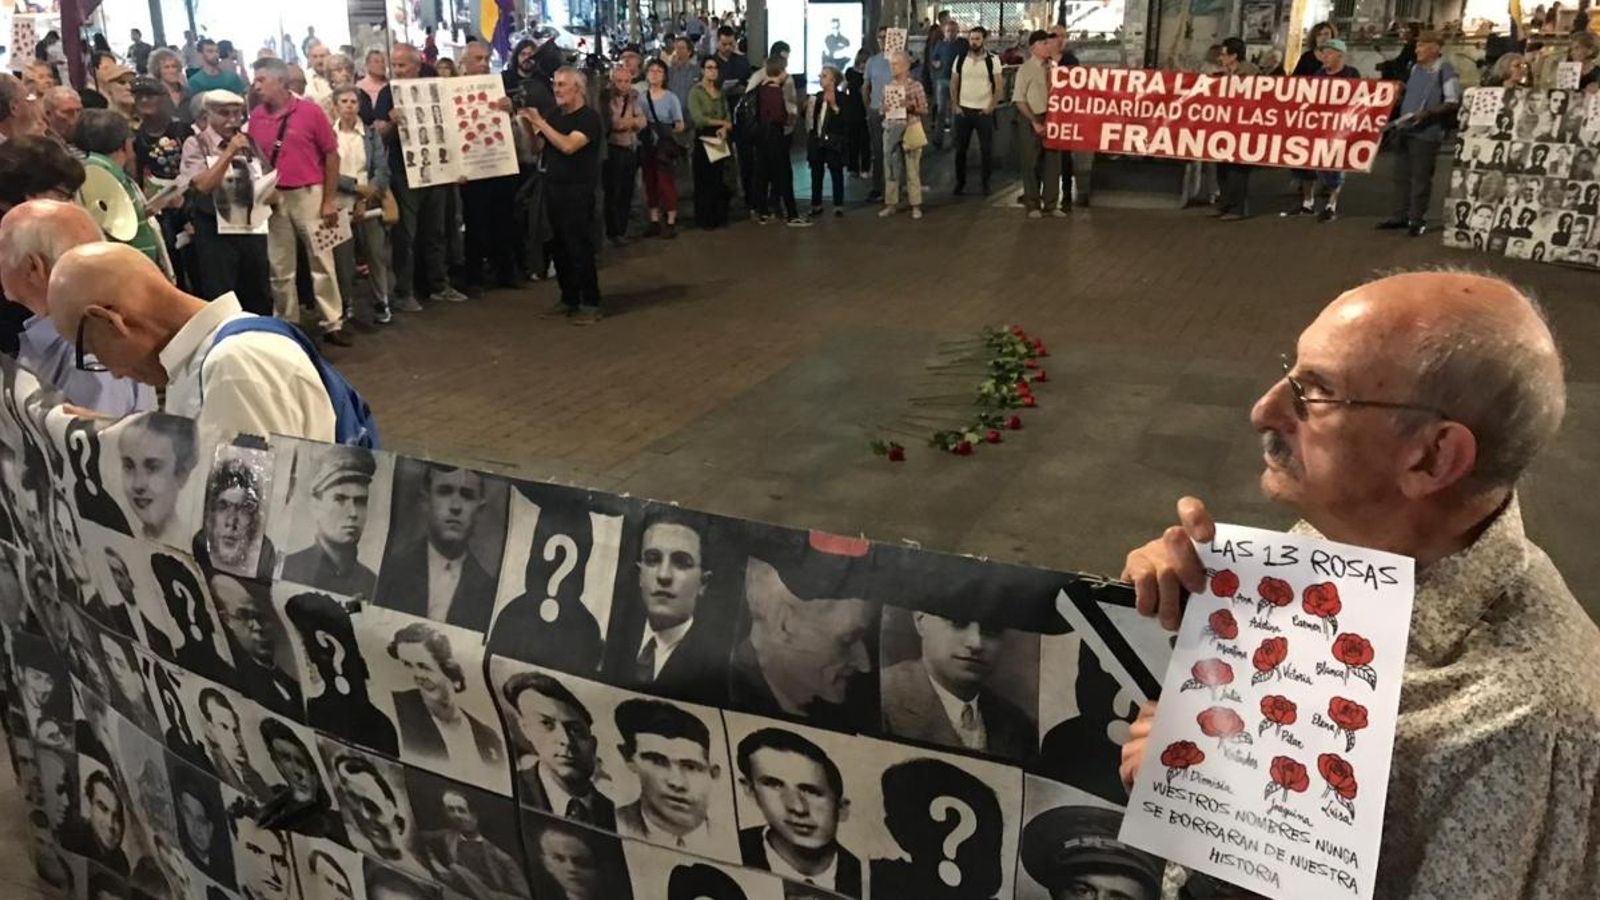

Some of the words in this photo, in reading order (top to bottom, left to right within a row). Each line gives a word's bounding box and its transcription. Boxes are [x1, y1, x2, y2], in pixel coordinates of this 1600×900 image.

[1051, 66, 1166, 95] CONTRA
[1173, 73, 1211, 97] LA
[1219, 75, 1395, 107] IMPUNIDAD
[1048, 95, 1182, 120] SOLIDARIDAD
[1188, 104, 1232, 123] CON
[1238, 106, 1278, 126] LAS
[1284, 103, 1388, 133] VÍCTIMAS
[1047, 123, 1084, 141] DEL
[1100, 122, 1379, 170] FRANQUISMO
[1211, 541, 1254, 563] LAS
[1264, 546, 1299, 567] 13
[1311, 549, 1399, 589] ROSAS
[1283, 663, 1313, 685] Victoria
[1316, 661, 1345, 680] Blanca
[1281, 730, 1304, 750] Pilar
[1311, 713, 1335, 733] Elena
[1153, 782, 1231, 815] VUESTROS
[1234, 810, 1311, 844] NOMBRES
[1321, 800, 1353, 826] Luisa
[1142, 801, 1164, 818] SE
[1169, 809, 1259, 852] BORRARAN
[1264, 843, 1286, 862] DE
[1290, 855, 1358, 895] NUESTRA
[1209, 847, 1280, 889] HISTORIA
